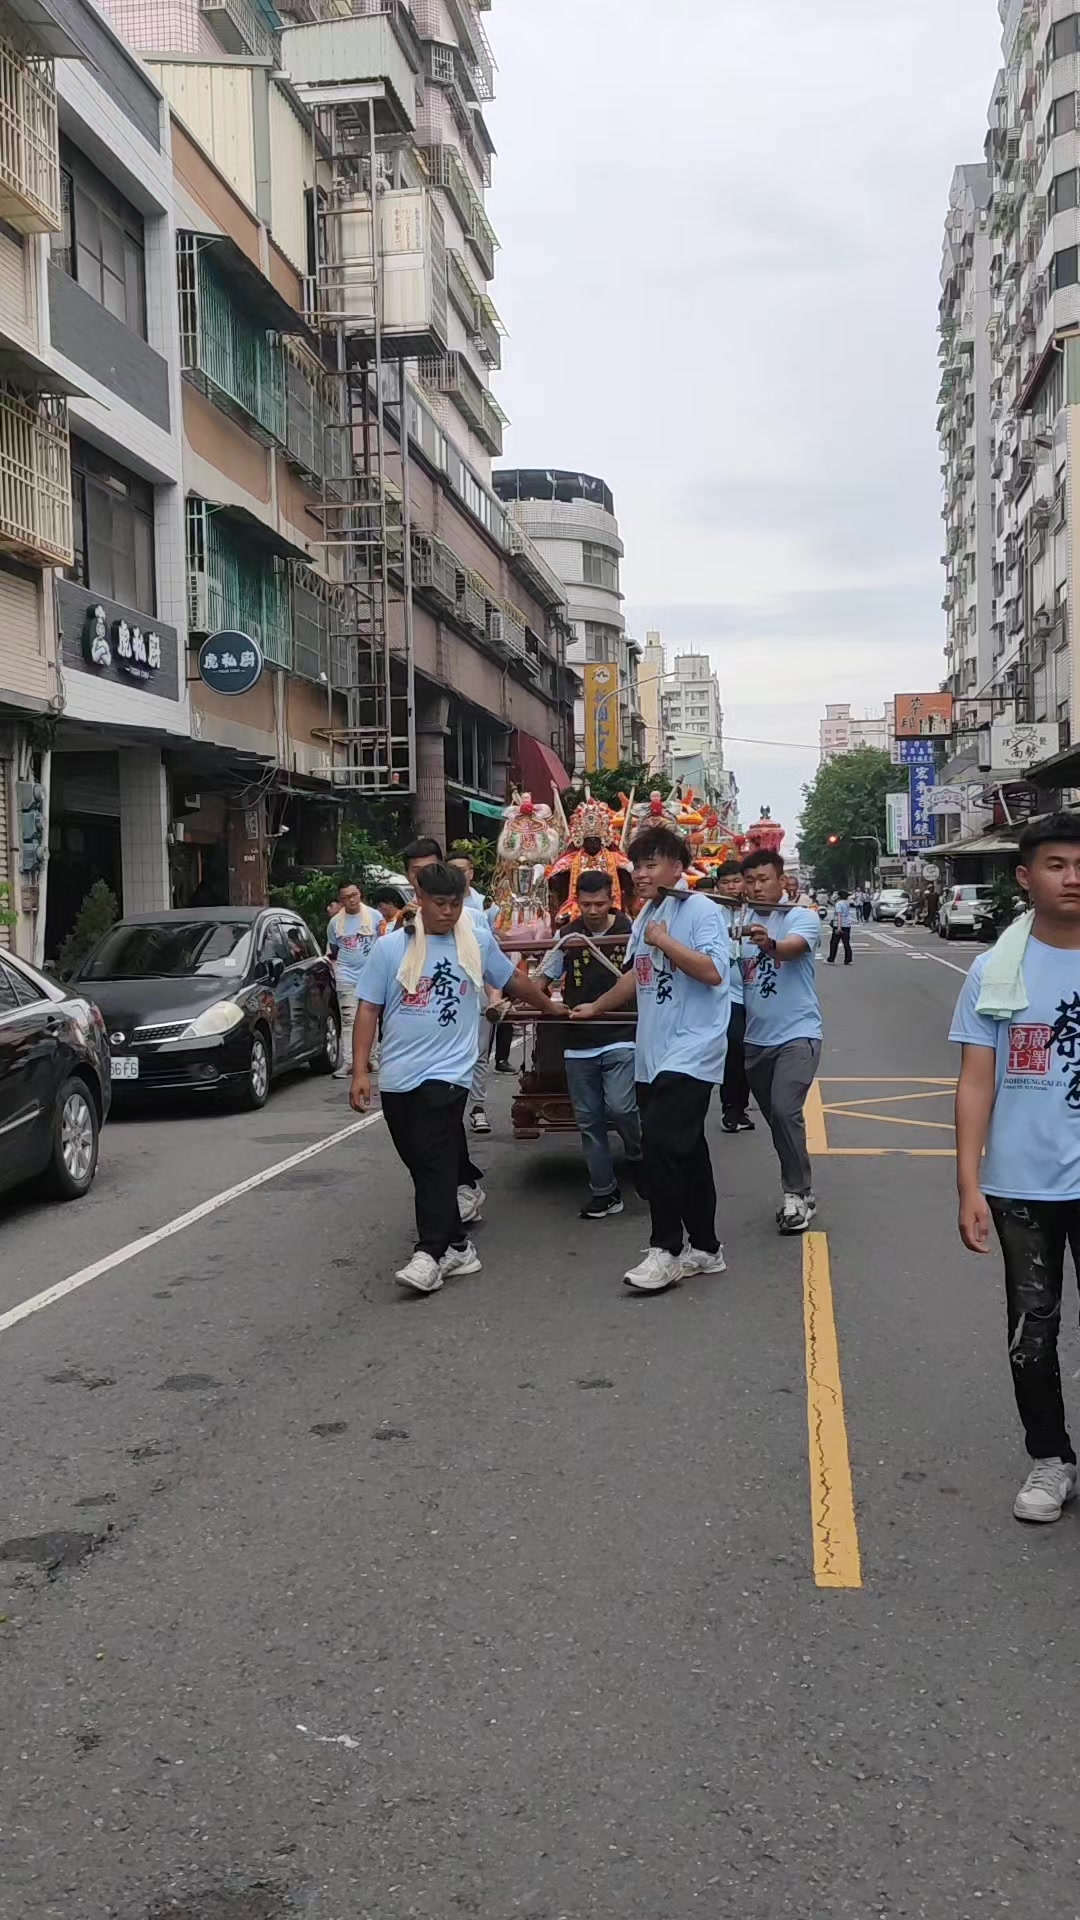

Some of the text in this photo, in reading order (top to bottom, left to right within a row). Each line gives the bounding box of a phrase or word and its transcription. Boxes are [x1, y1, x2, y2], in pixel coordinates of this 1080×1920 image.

[117, 619, 161, 669] 虎私廚
[203, 650, 256, 669] 虎私廚
[427, 956, 461, 1028] 蔡家
